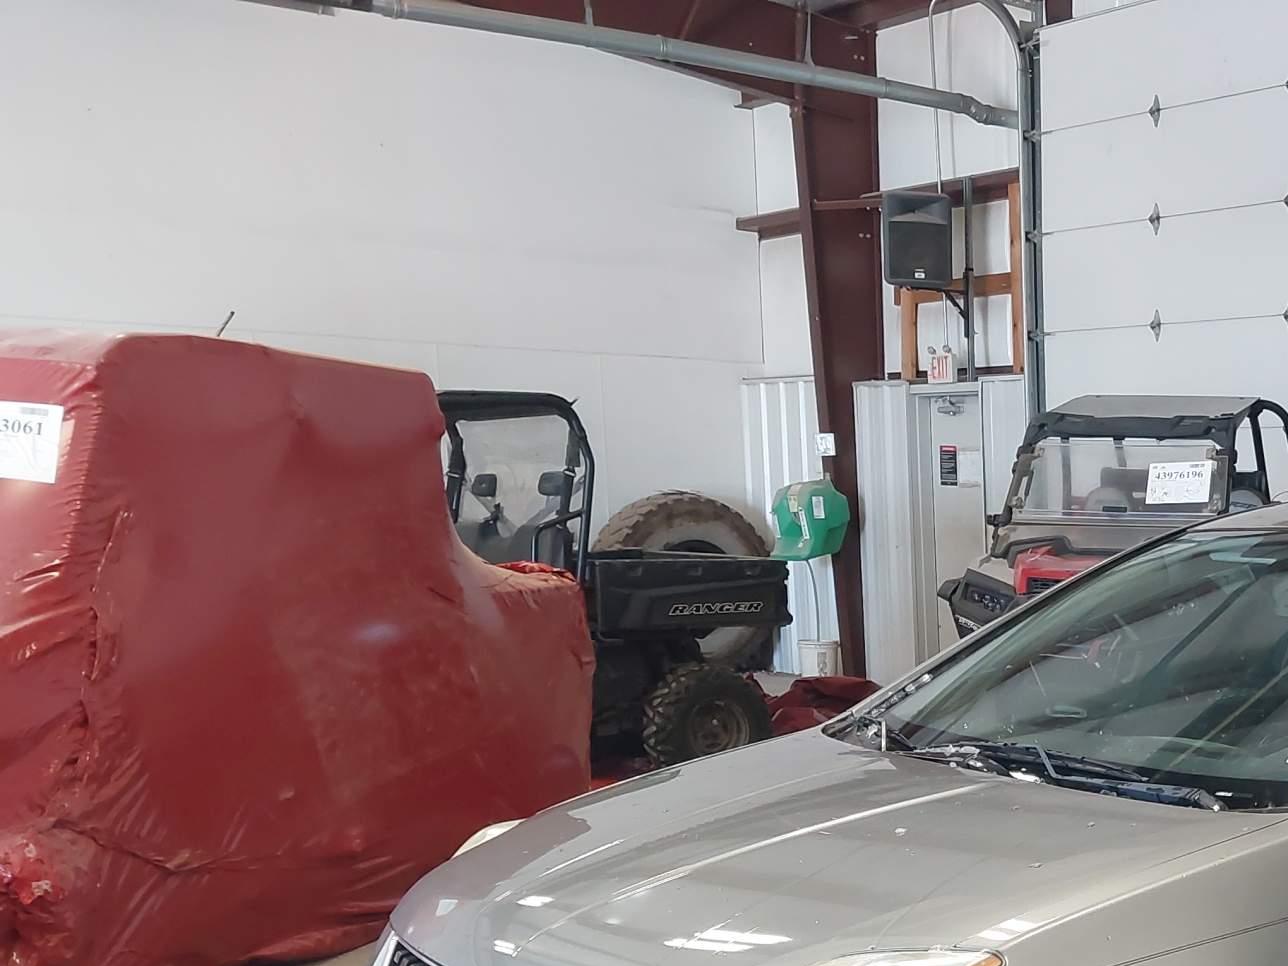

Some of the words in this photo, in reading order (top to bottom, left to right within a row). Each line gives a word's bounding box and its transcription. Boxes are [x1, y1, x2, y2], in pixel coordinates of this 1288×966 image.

[931, 356, 948, 379] EXIT
[1154, 470, 1204, 480] 43976196
[668, 601, 763, 616] RANGER
